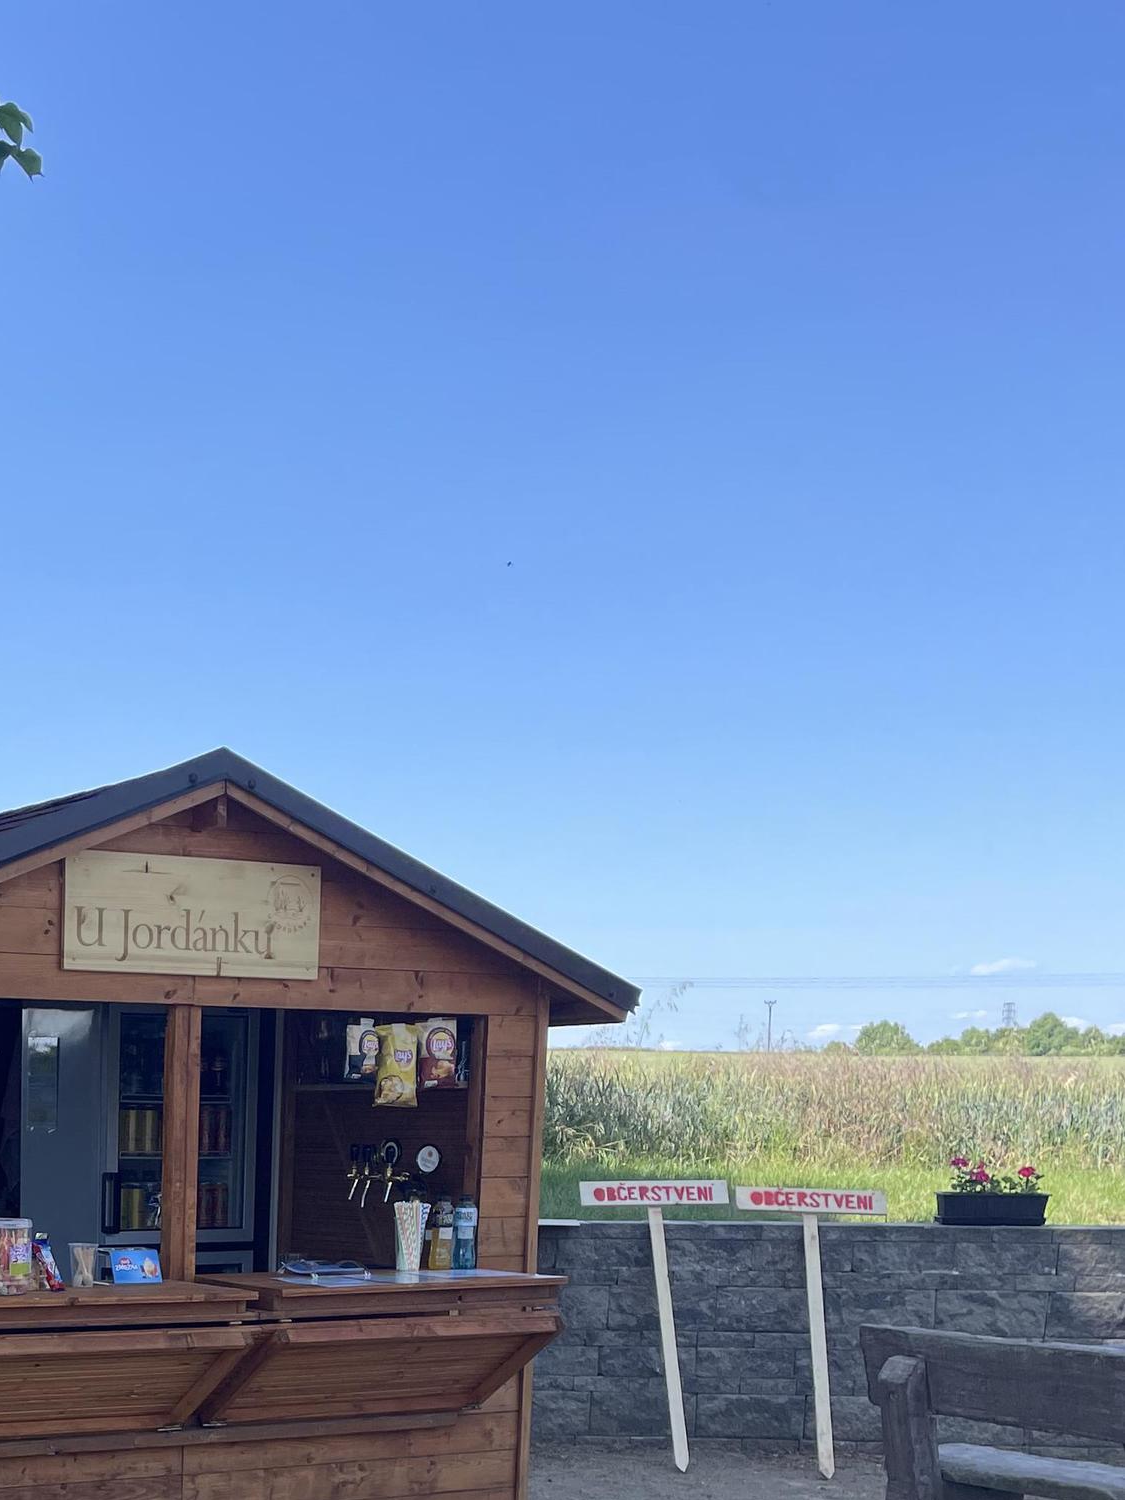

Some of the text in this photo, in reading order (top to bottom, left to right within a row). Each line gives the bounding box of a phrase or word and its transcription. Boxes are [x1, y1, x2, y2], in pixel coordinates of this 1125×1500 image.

[75, 905, 274, 961] U Jordánku
[593, 1182, 714, 1202] OBČERSTVENÍ
[750, 1187, 875, 1211] OBČERSTVENÍ
